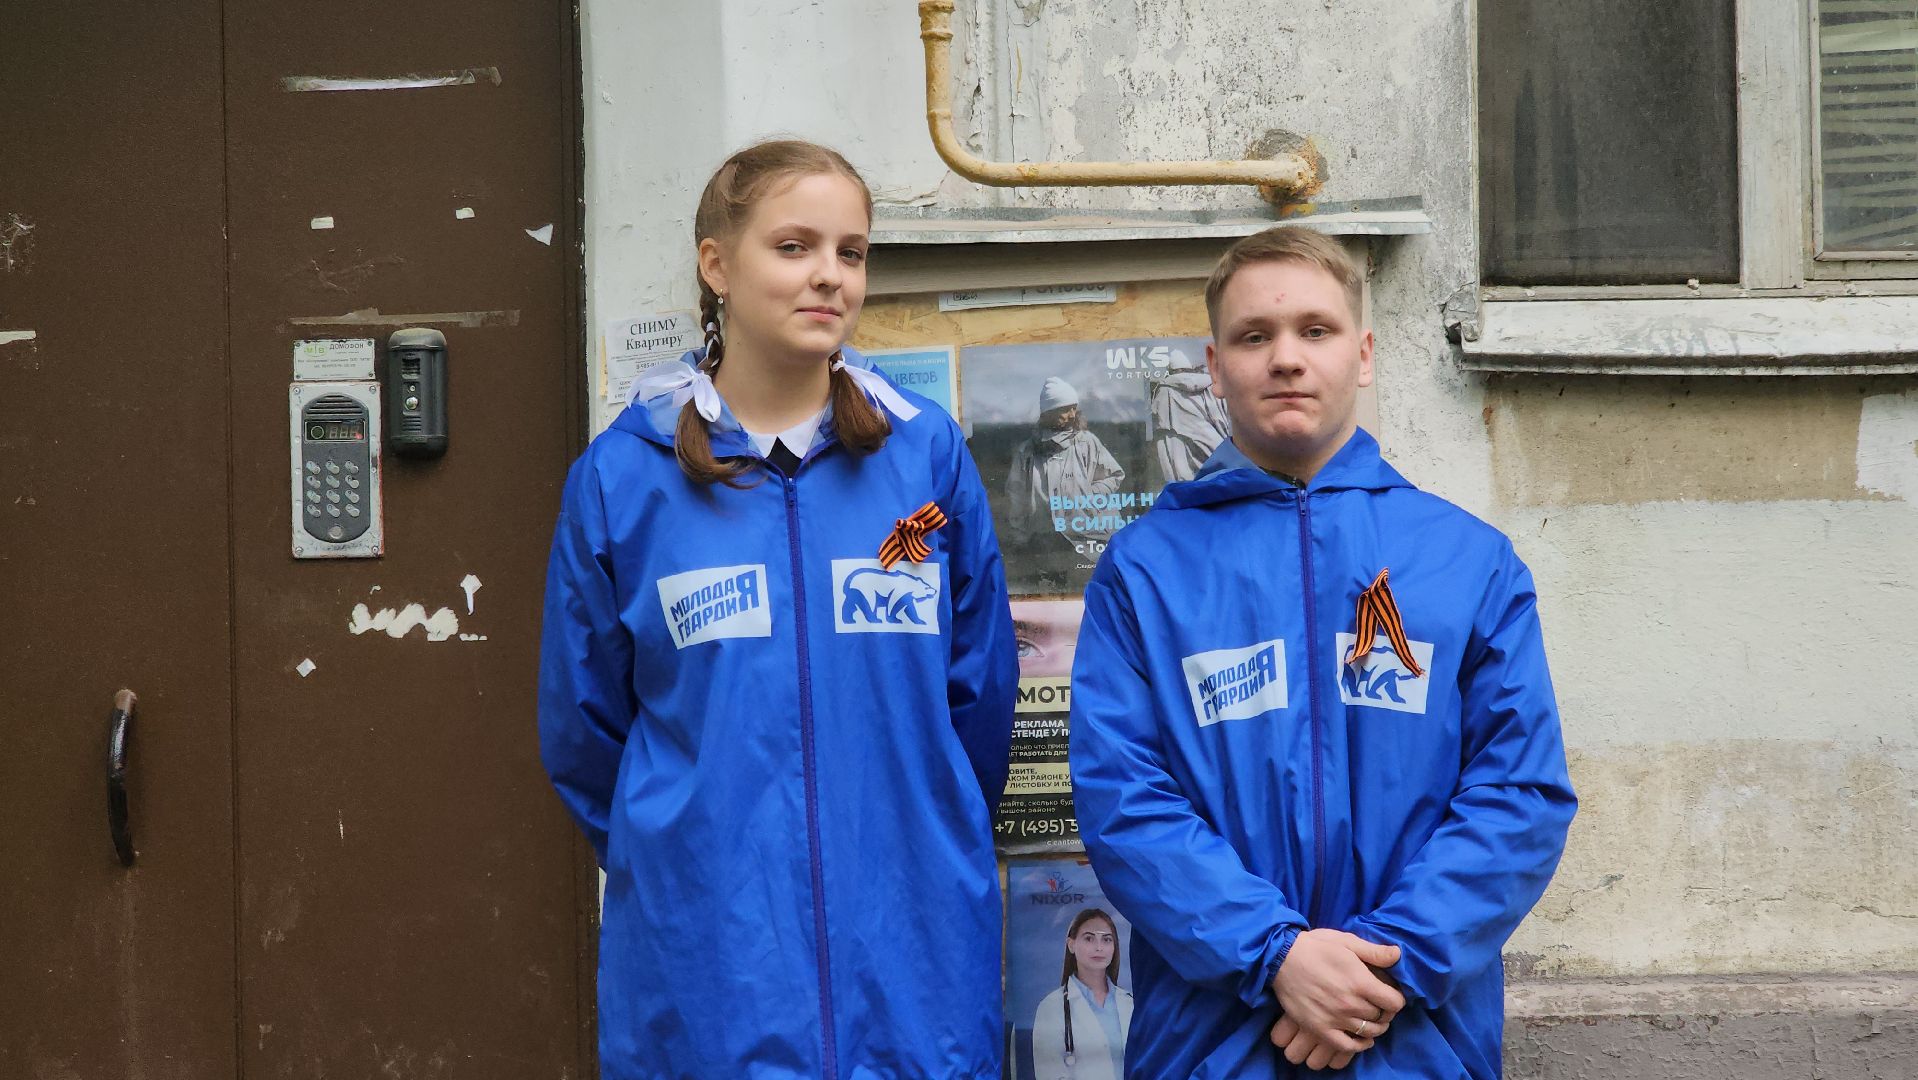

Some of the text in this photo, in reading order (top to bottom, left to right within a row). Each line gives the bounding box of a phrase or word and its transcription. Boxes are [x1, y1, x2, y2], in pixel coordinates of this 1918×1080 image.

[630, 317, 678, 335] СНИМУ
[626, 335, 683, 350] Квартиру
[1106, 346, 1170, 370] WKS
[1108, 370, 1171, 379] TORTUGA
[1049, 492, 1161, 511] ВЫХОДИ Н
[1054, 517, 1067, 532] В
[1075, 544, 1085, 554] с
[670, 570, 760, 622] МОЛОДАЯ
[1198, 645, 1277, 699] МОЛОДАЯ
[1014, 719, 1065, 729] РЕКЛАМА
[1011, 729, 1050, 738] СТЕНДЕ
[1031, 773, 1063, 781] РАЙОНЕ
[995, 820, 1016, 834] +7
[1021, 818, 1065, 837] (495)
[1032, 893, 1085, 905] NIXOR
